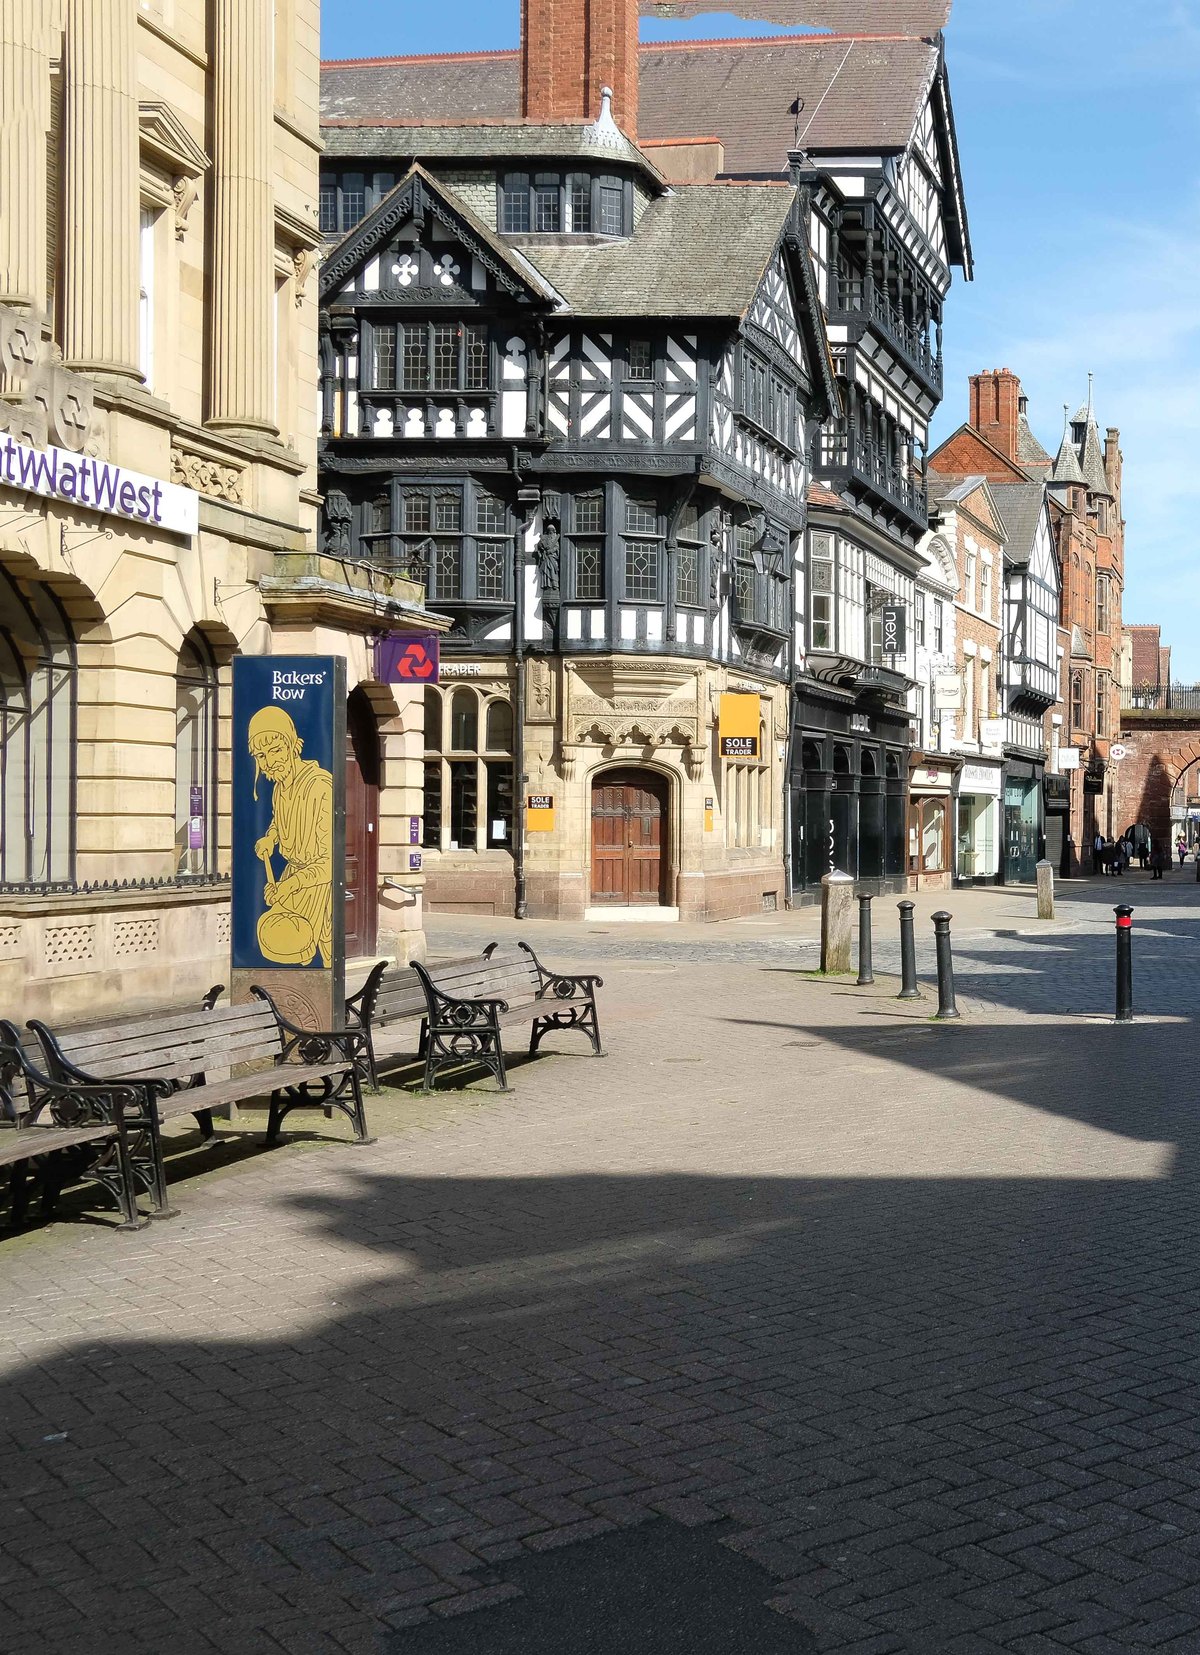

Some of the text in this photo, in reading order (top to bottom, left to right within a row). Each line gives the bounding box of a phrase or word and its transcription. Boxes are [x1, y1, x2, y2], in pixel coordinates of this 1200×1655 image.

[885, 612, 897, 650] next
[272, 685, 305, 701] Row
[725, 738, 752, 747] SOLE
[531, 796, 550, 804] SOLE
